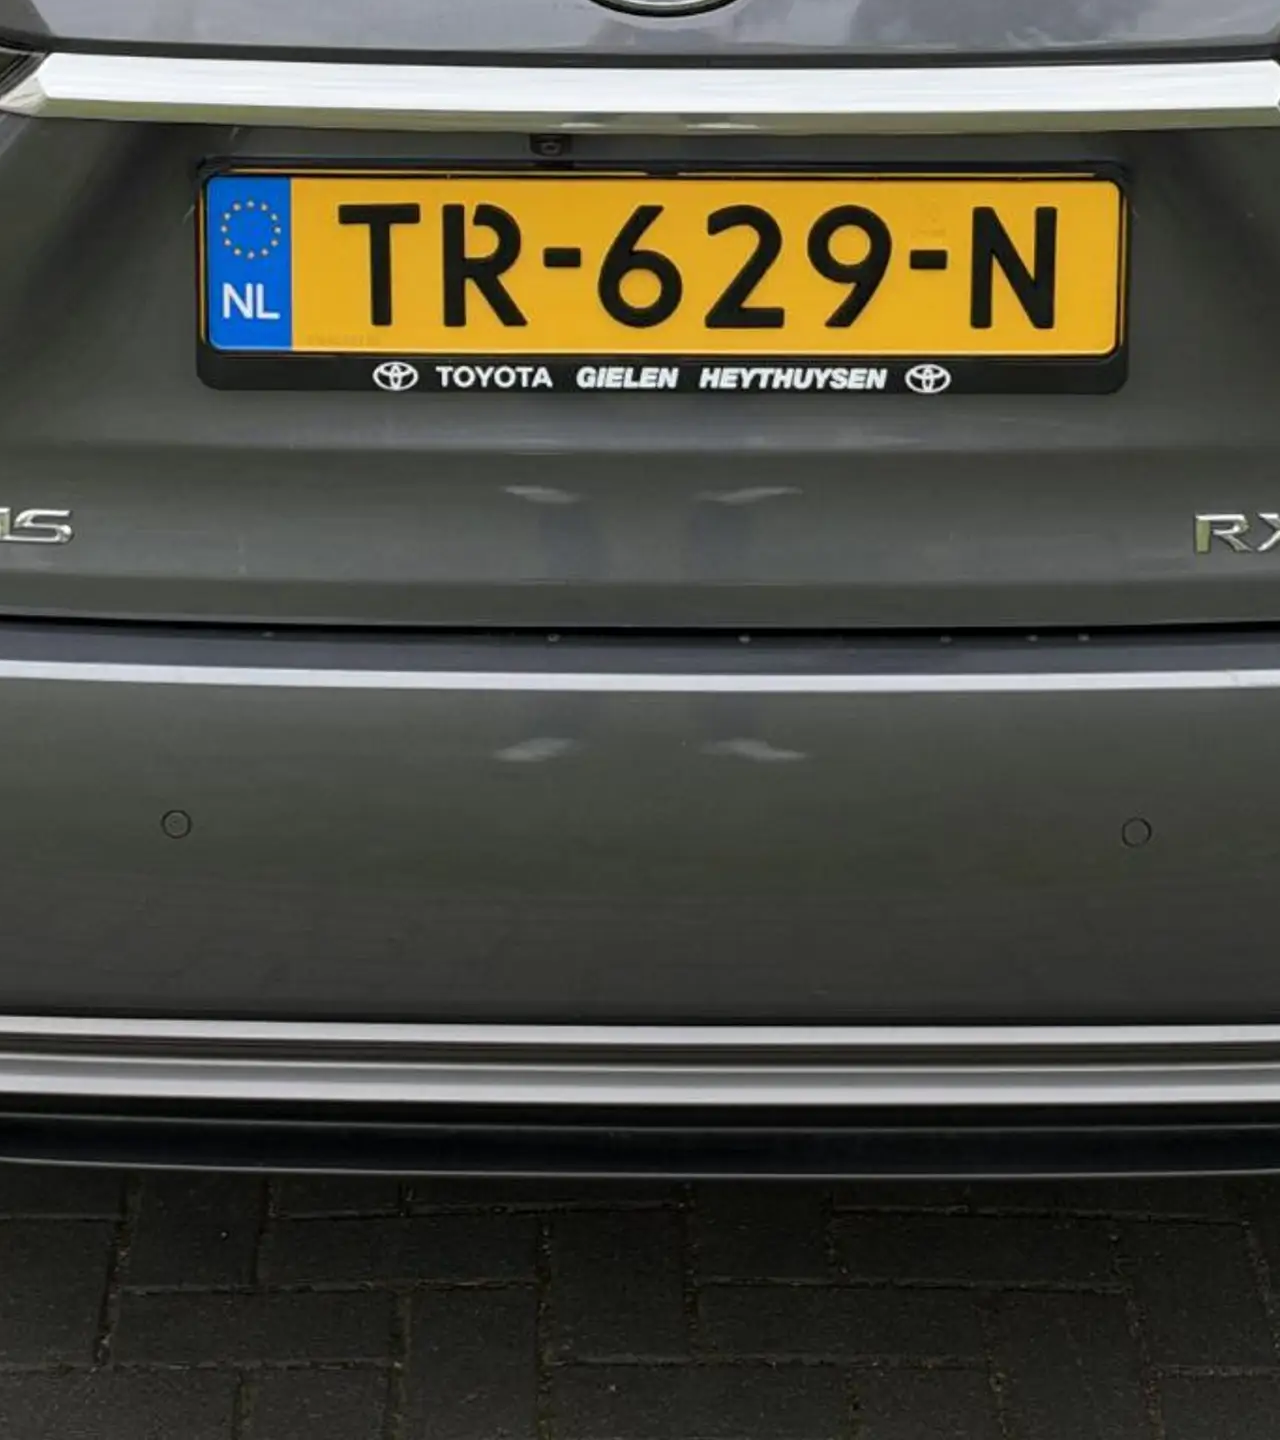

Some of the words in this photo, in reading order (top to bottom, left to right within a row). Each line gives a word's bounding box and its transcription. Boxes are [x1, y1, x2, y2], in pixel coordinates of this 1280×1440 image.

[338, 202, 1058, 329] TR-629-N
[222, 283, 280, 320] NL
[436, 366, 553, 389] TOYOTA
[576, 367, 679, 390] GIELEN
[699, 368, 888, 391] HEYTHUYSEN
